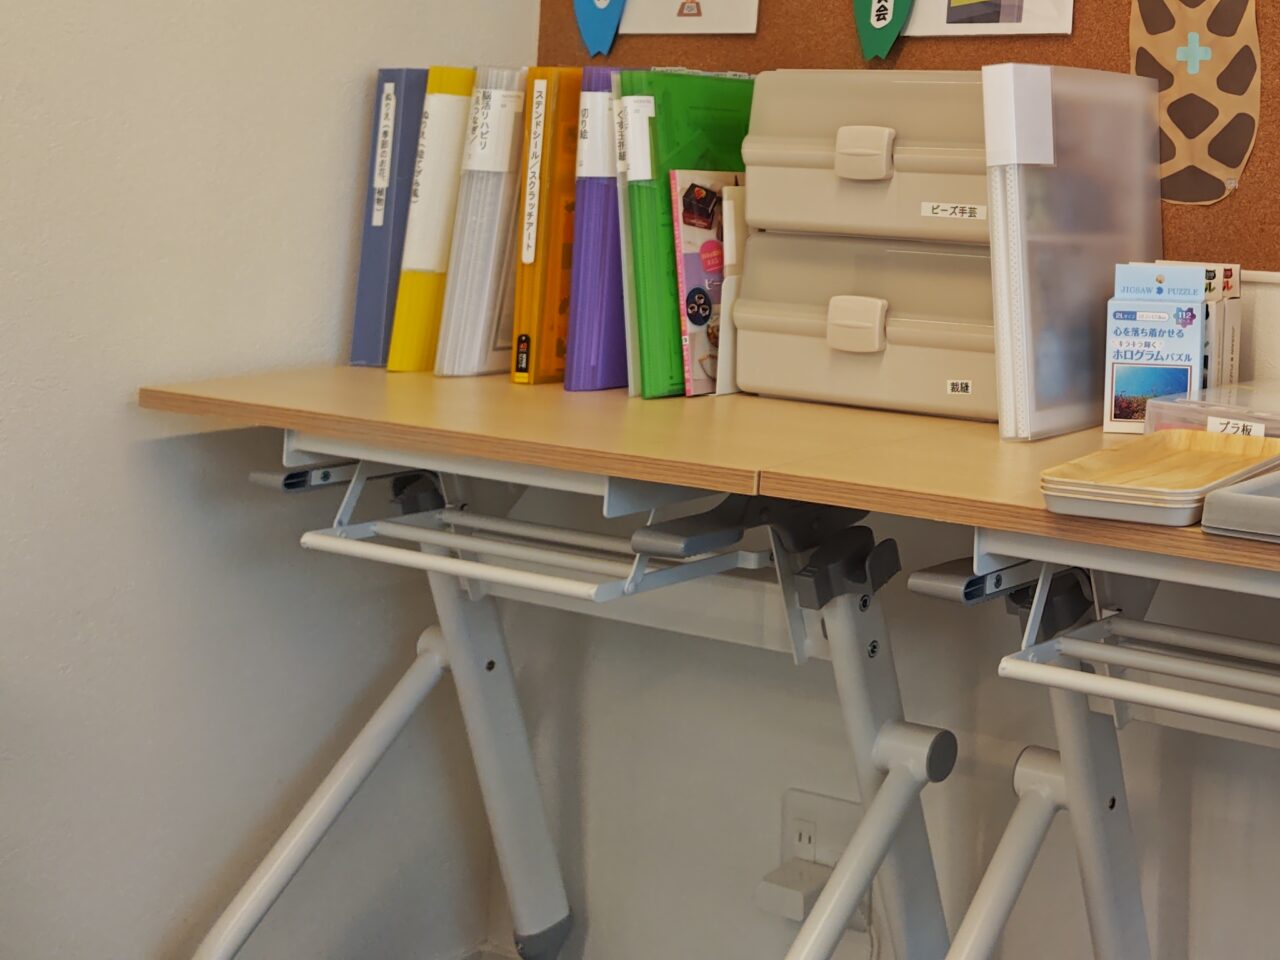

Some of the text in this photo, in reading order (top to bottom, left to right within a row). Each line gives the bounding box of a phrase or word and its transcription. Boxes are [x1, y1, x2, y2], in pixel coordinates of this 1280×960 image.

[478, 89, 492, 150] 脳活リハビリ
[580, 108, 590, 140] 切り絵
[526, 91, 543, 250] ステンドシール／スクラッチアート
[930, 204, 978, 219] ビーズ手芸
[1120, 286, 1199, 296] JIGSAW PUZZLE
[1178, 310, 1192, 319] 112
[1113, 326, 1184, 339] 心を落ち着かせる
[1112, 349, 1193, 363] ホログラムパズル
[950, 381, 970, 395] 裁縫
[1219, 421, 1253, 436] プラ板
